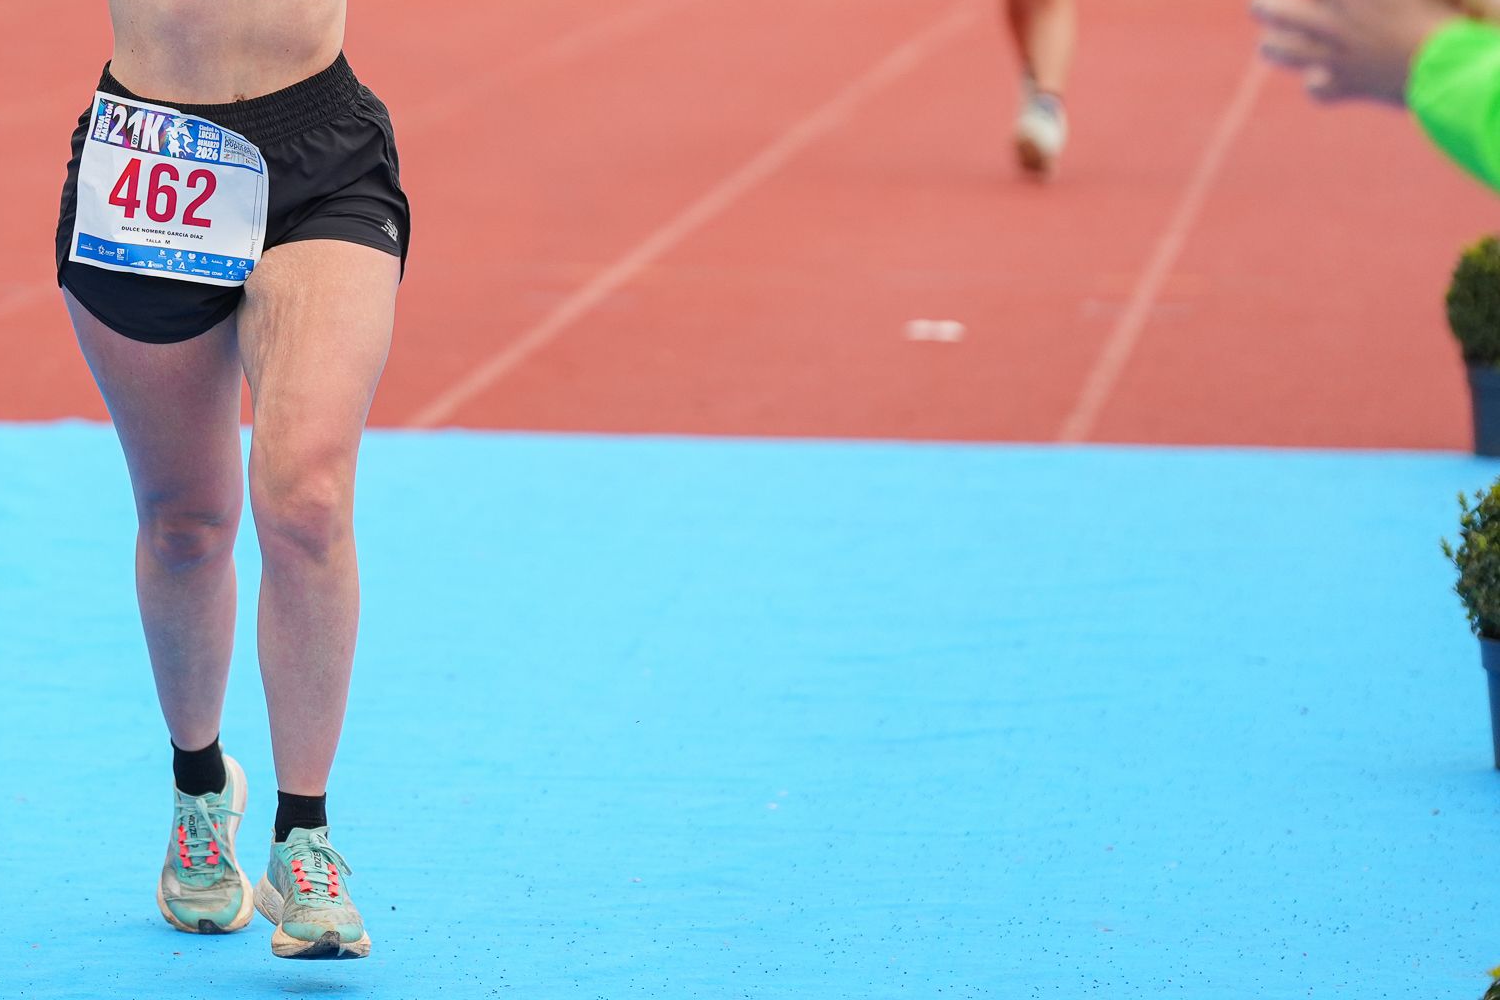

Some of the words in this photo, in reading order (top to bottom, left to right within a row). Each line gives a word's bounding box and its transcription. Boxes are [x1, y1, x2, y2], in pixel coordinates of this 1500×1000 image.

[93, 115, 106, 139] MEDIA
[99, 103, 114, 140] MARATÓN
[107, 105, 166, 152] 21K
[198, 130, 219, 140] LUCENA
[195, 146, 218, 160] 2026
[108, 157, 217, 228] 462
[167, 230, 189, 238] GARCÍA
